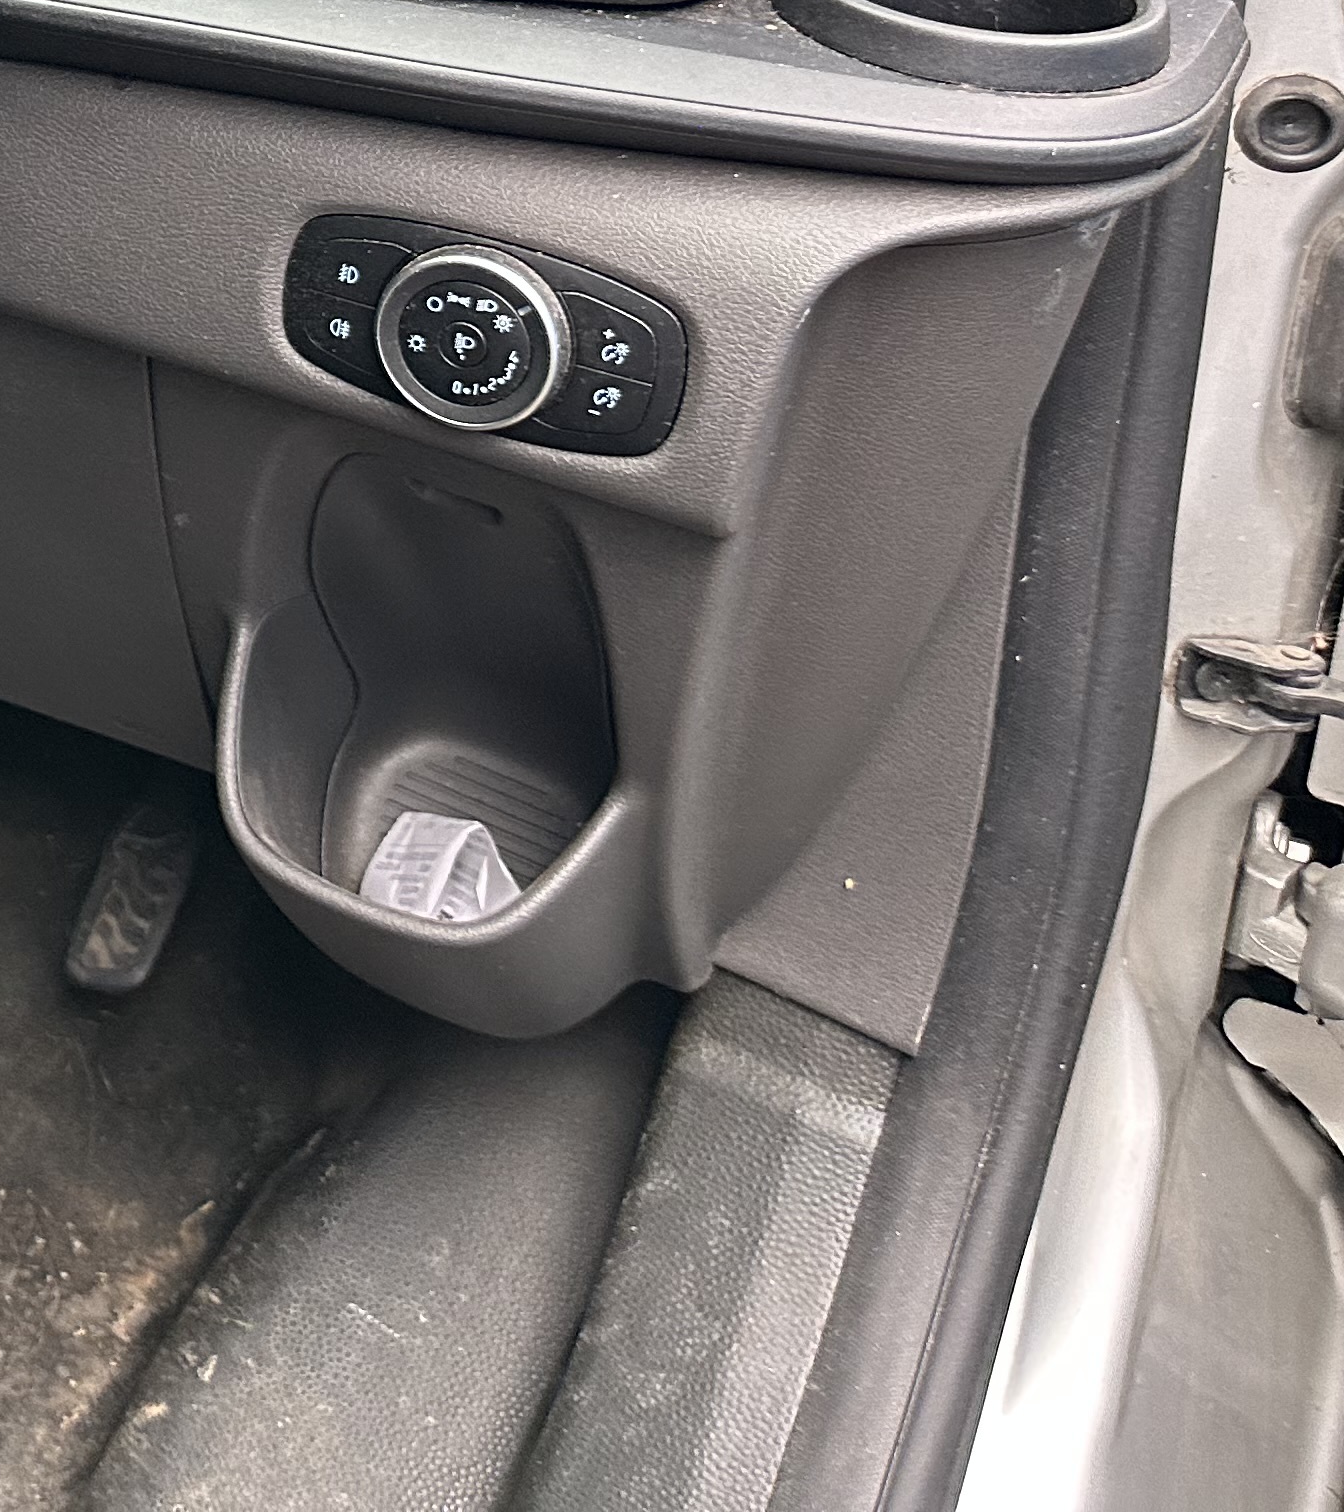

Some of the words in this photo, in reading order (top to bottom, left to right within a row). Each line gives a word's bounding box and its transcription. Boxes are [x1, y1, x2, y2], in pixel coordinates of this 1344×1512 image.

[472, 383, 480, 396] 1
[487, 377, 497, 391] 2
[502, 367, 513, 380] 3
